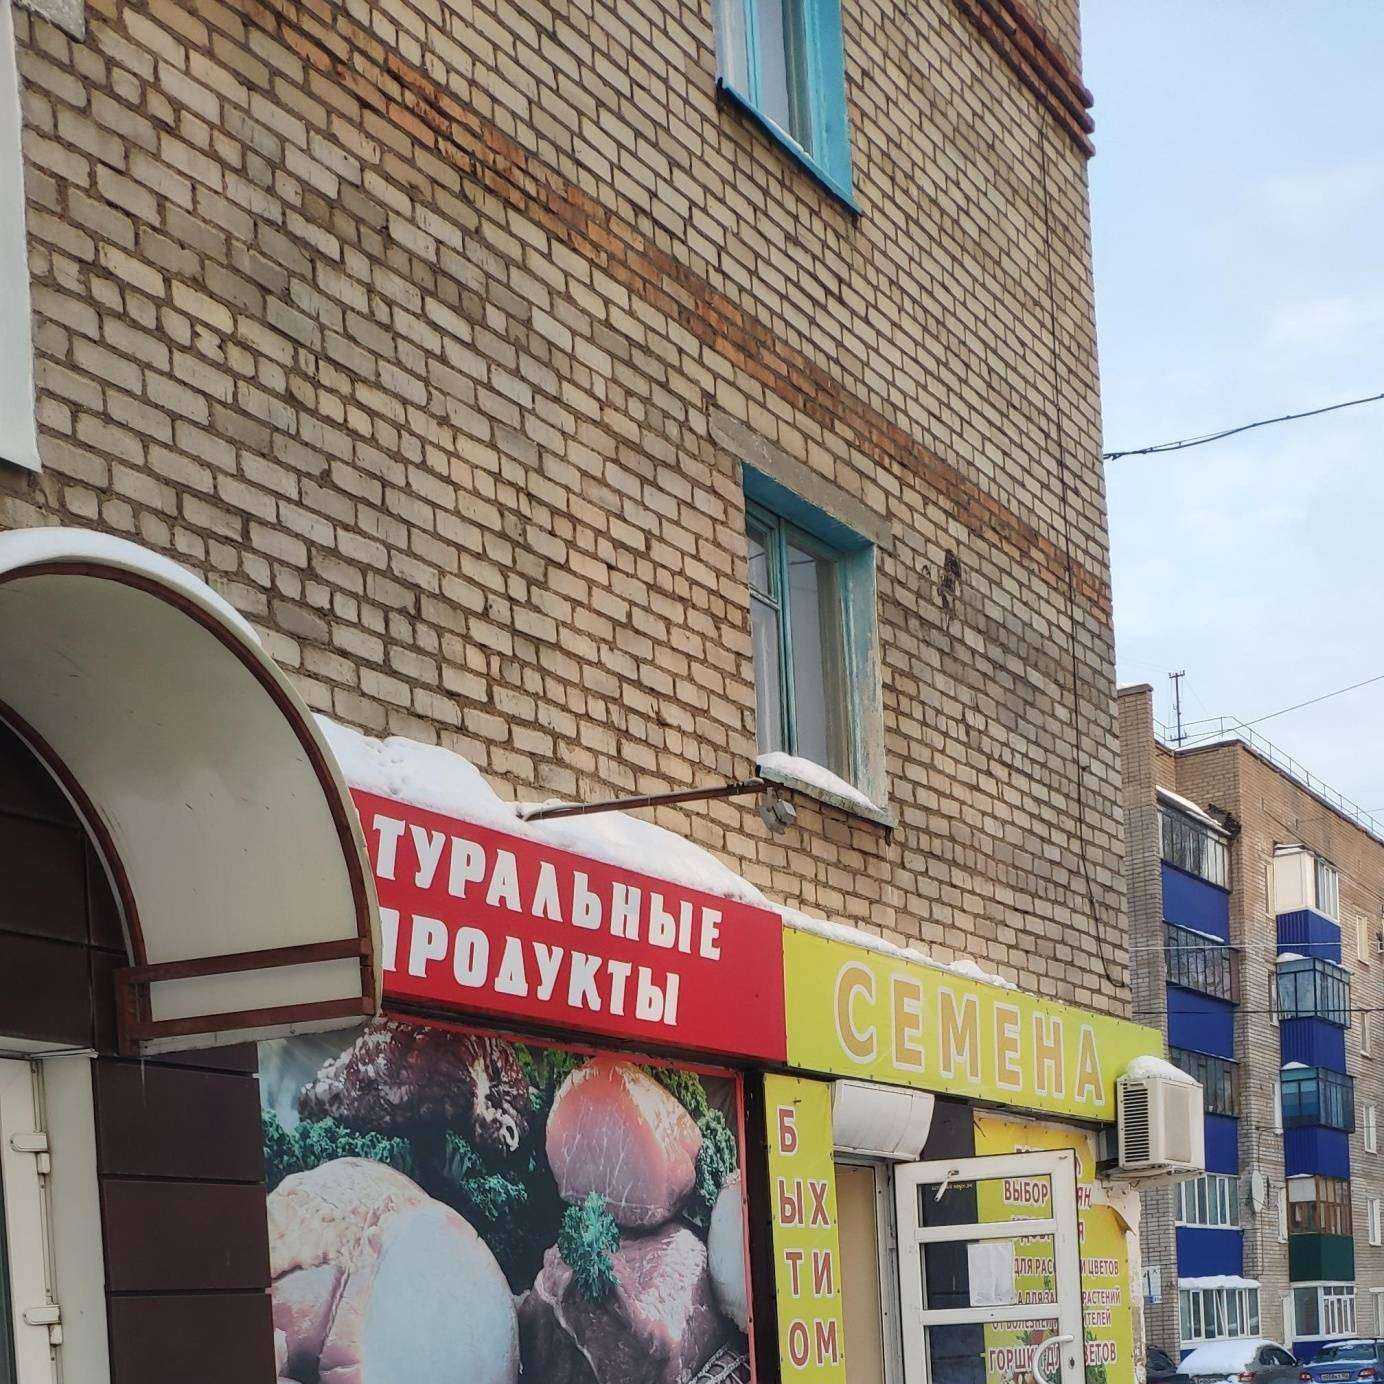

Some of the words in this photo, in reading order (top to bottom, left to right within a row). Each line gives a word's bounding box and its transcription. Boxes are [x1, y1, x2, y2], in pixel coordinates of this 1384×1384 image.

[372, 813, 722, 961] ТУРАЛЬНЫЕ
[834, 960, 1105, 1106] СЕМЕНА
[1004, 1179, 1049, 1205] ВЫБОР
[1089, 1258, 1119, 1276] ЦВЕТОВ
[1082, 1287, 1121, 1304] РАСТЕНИЙ
[990, 1347, 1034, 1371] ГОРШК
